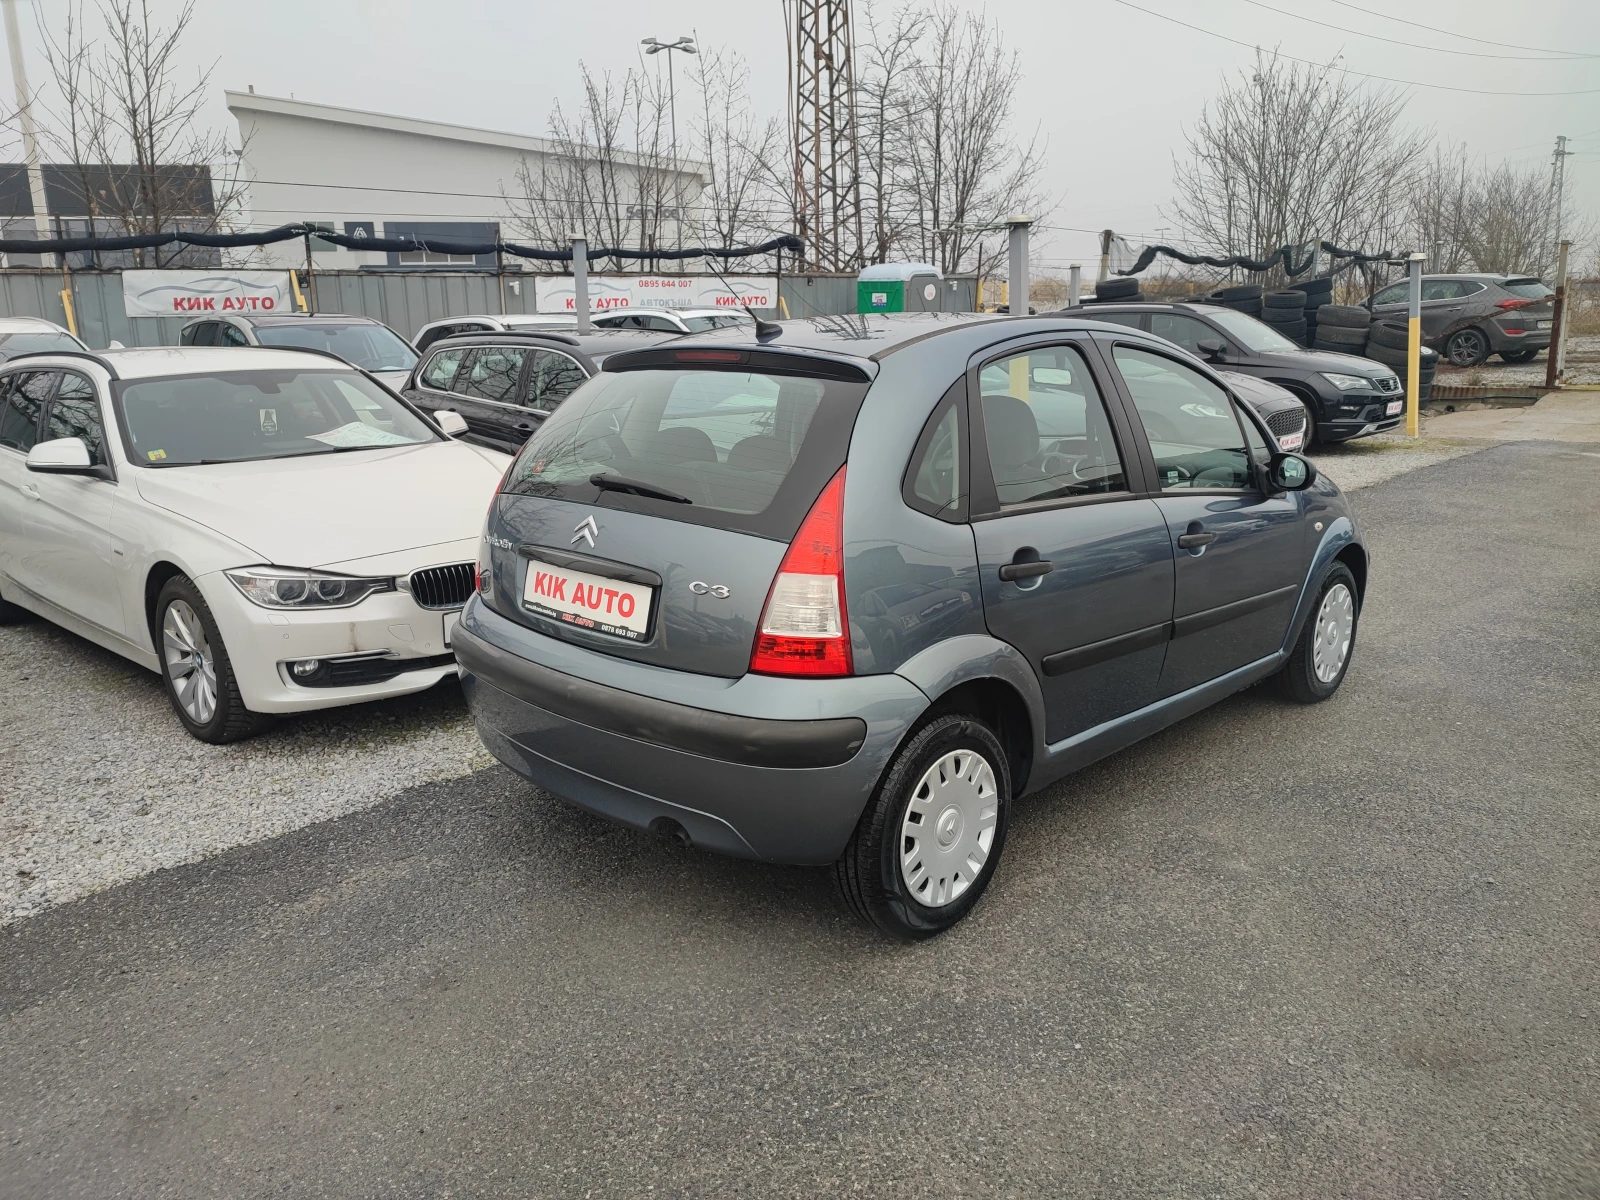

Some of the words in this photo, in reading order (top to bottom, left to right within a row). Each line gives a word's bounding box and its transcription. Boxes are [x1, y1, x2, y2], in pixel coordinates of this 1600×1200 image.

[638, 280, 659, 288] 0895
[661, 280, 676, 288] 644
[678, 280, 692, 288] 007
[173, 297, 216, 311] КИК
[222, 296, 275, 310] АУТО
[596, 297, 629, 309] АУТО
[715, 296, 737, 306] КИК
[740, 296, 767, 306] АУТО
[534, 571, 567, 602] KIK
[571, 582, 635, 618] AUTO
